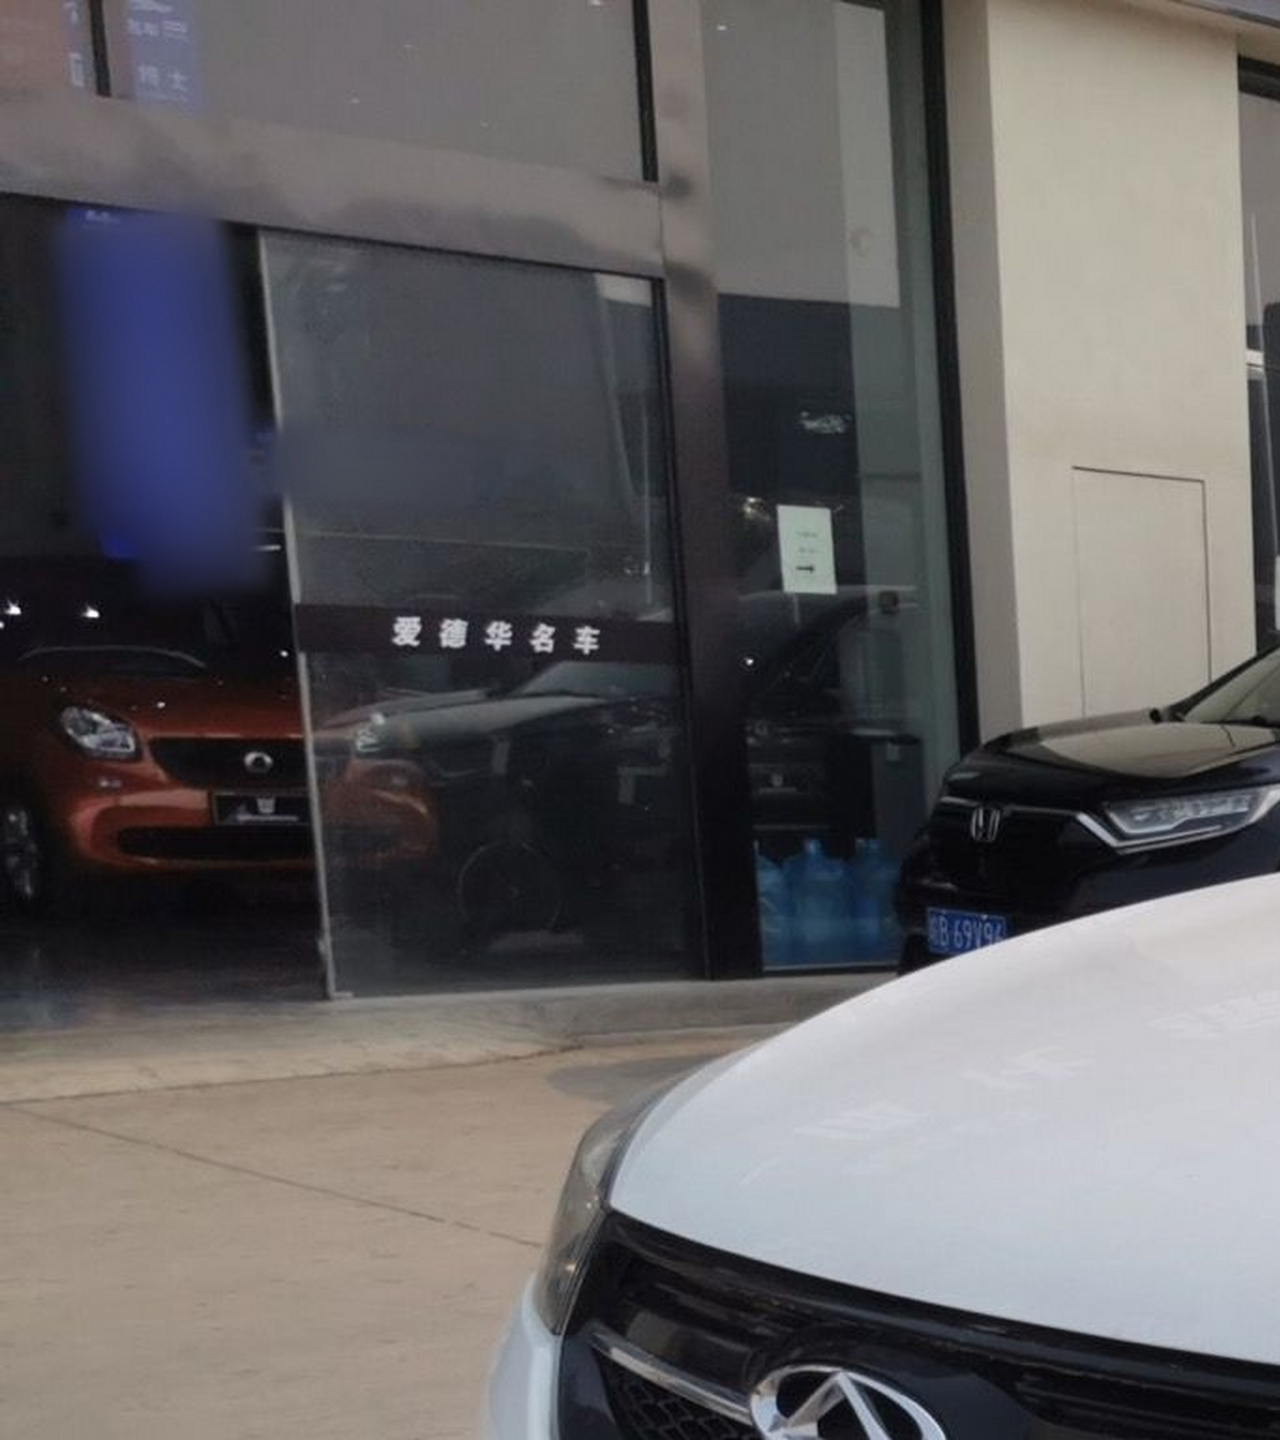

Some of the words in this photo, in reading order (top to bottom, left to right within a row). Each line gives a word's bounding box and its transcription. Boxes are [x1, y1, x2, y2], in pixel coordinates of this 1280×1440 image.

[391, 616, 602, 655] 爱德华名车
